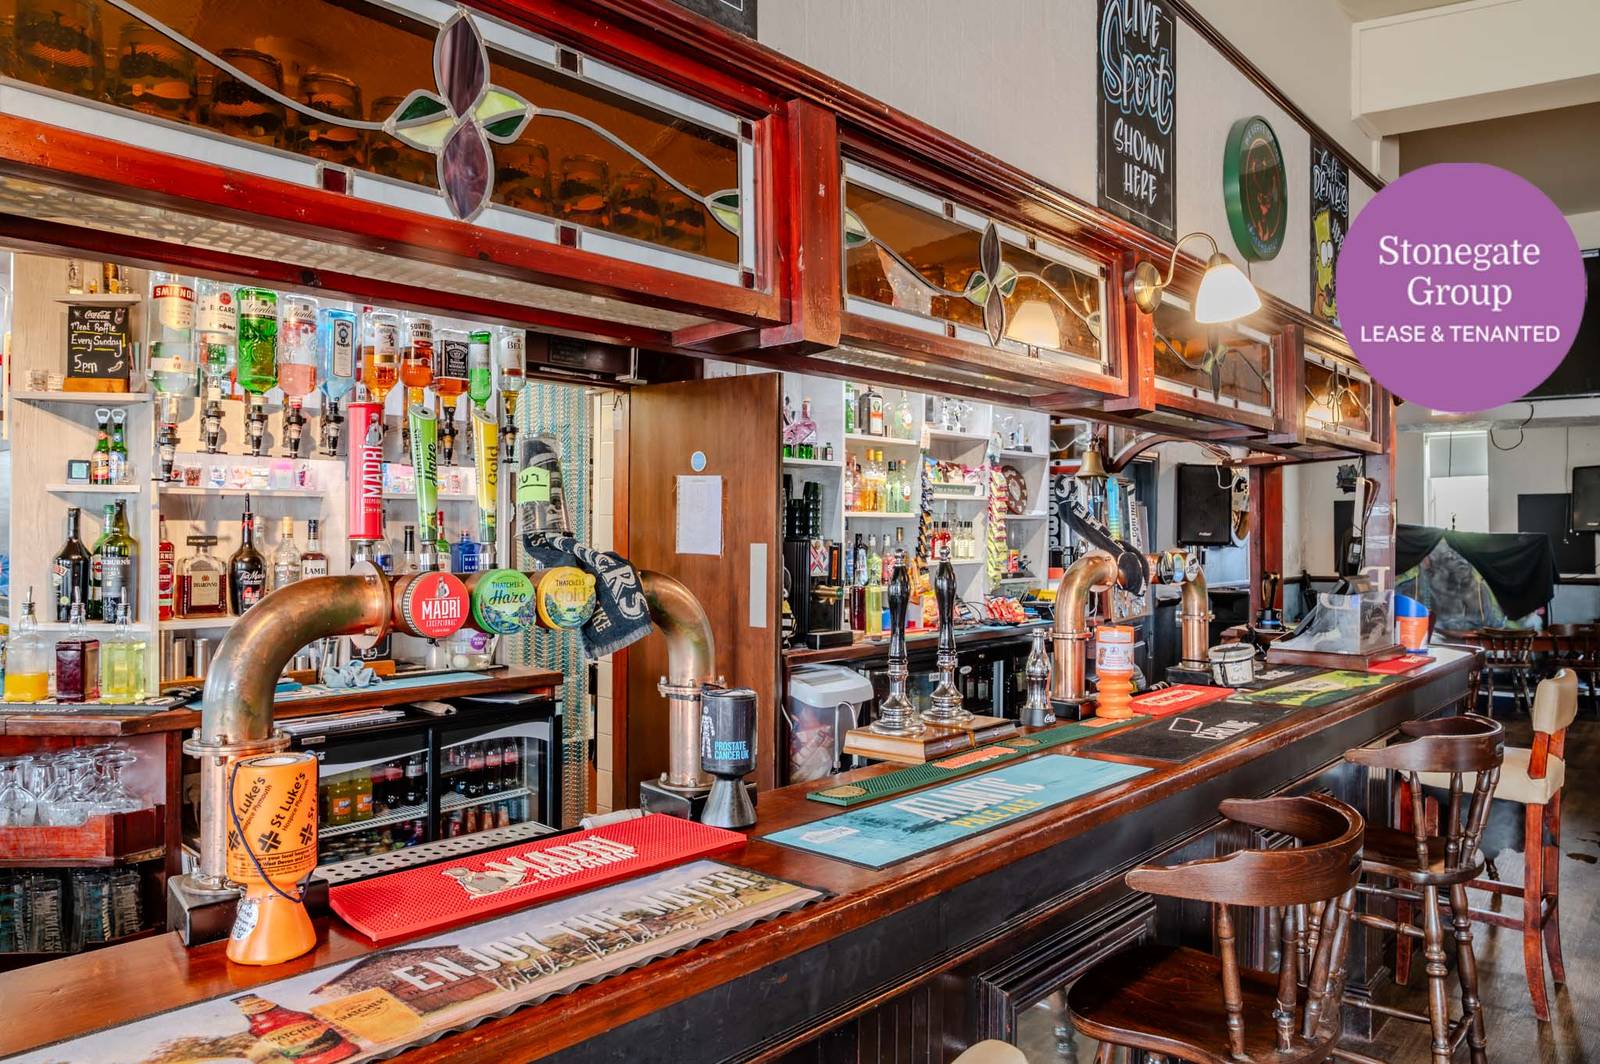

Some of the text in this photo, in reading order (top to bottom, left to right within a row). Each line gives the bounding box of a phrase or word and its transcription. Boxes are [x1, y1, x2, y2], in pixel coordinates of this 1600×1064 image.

[1124, 0, 1162, 47] LIVE
[1102, 1, 1174, 132] Sport
[1114, 118, 1165, 174] SHOWN
[1123, 162, 1157, 205] HERE
[71, 322, 91, 332] Meat
[71, 333, 93, 351] Every
[74, 354, 98, 373] 5pm
[425, 443, 437, 487] Haze
[488, 446, 499, 486] Gold
[488, 592, 527, 606] Haze
[492, 581, 524, 590] THATCHERS
[714, 741, 746, 751] PROSTATE
[714, 749, 749, 760] CANCER UK
[239, 776, 266, 814] Luke's
[253, 784, 272, 810] Plymouth
[271, 772, 306, 828] St Luke's
[890, 777, 1045, 822] ATLANTIC
[282, 808, 297, 831] Hospice
[951, 799, 1043, 828] PALE ALE
[391, 871, 759, 992] ENJOY THE MATCH
[337, 997, 389, 1022] THATCHERS
